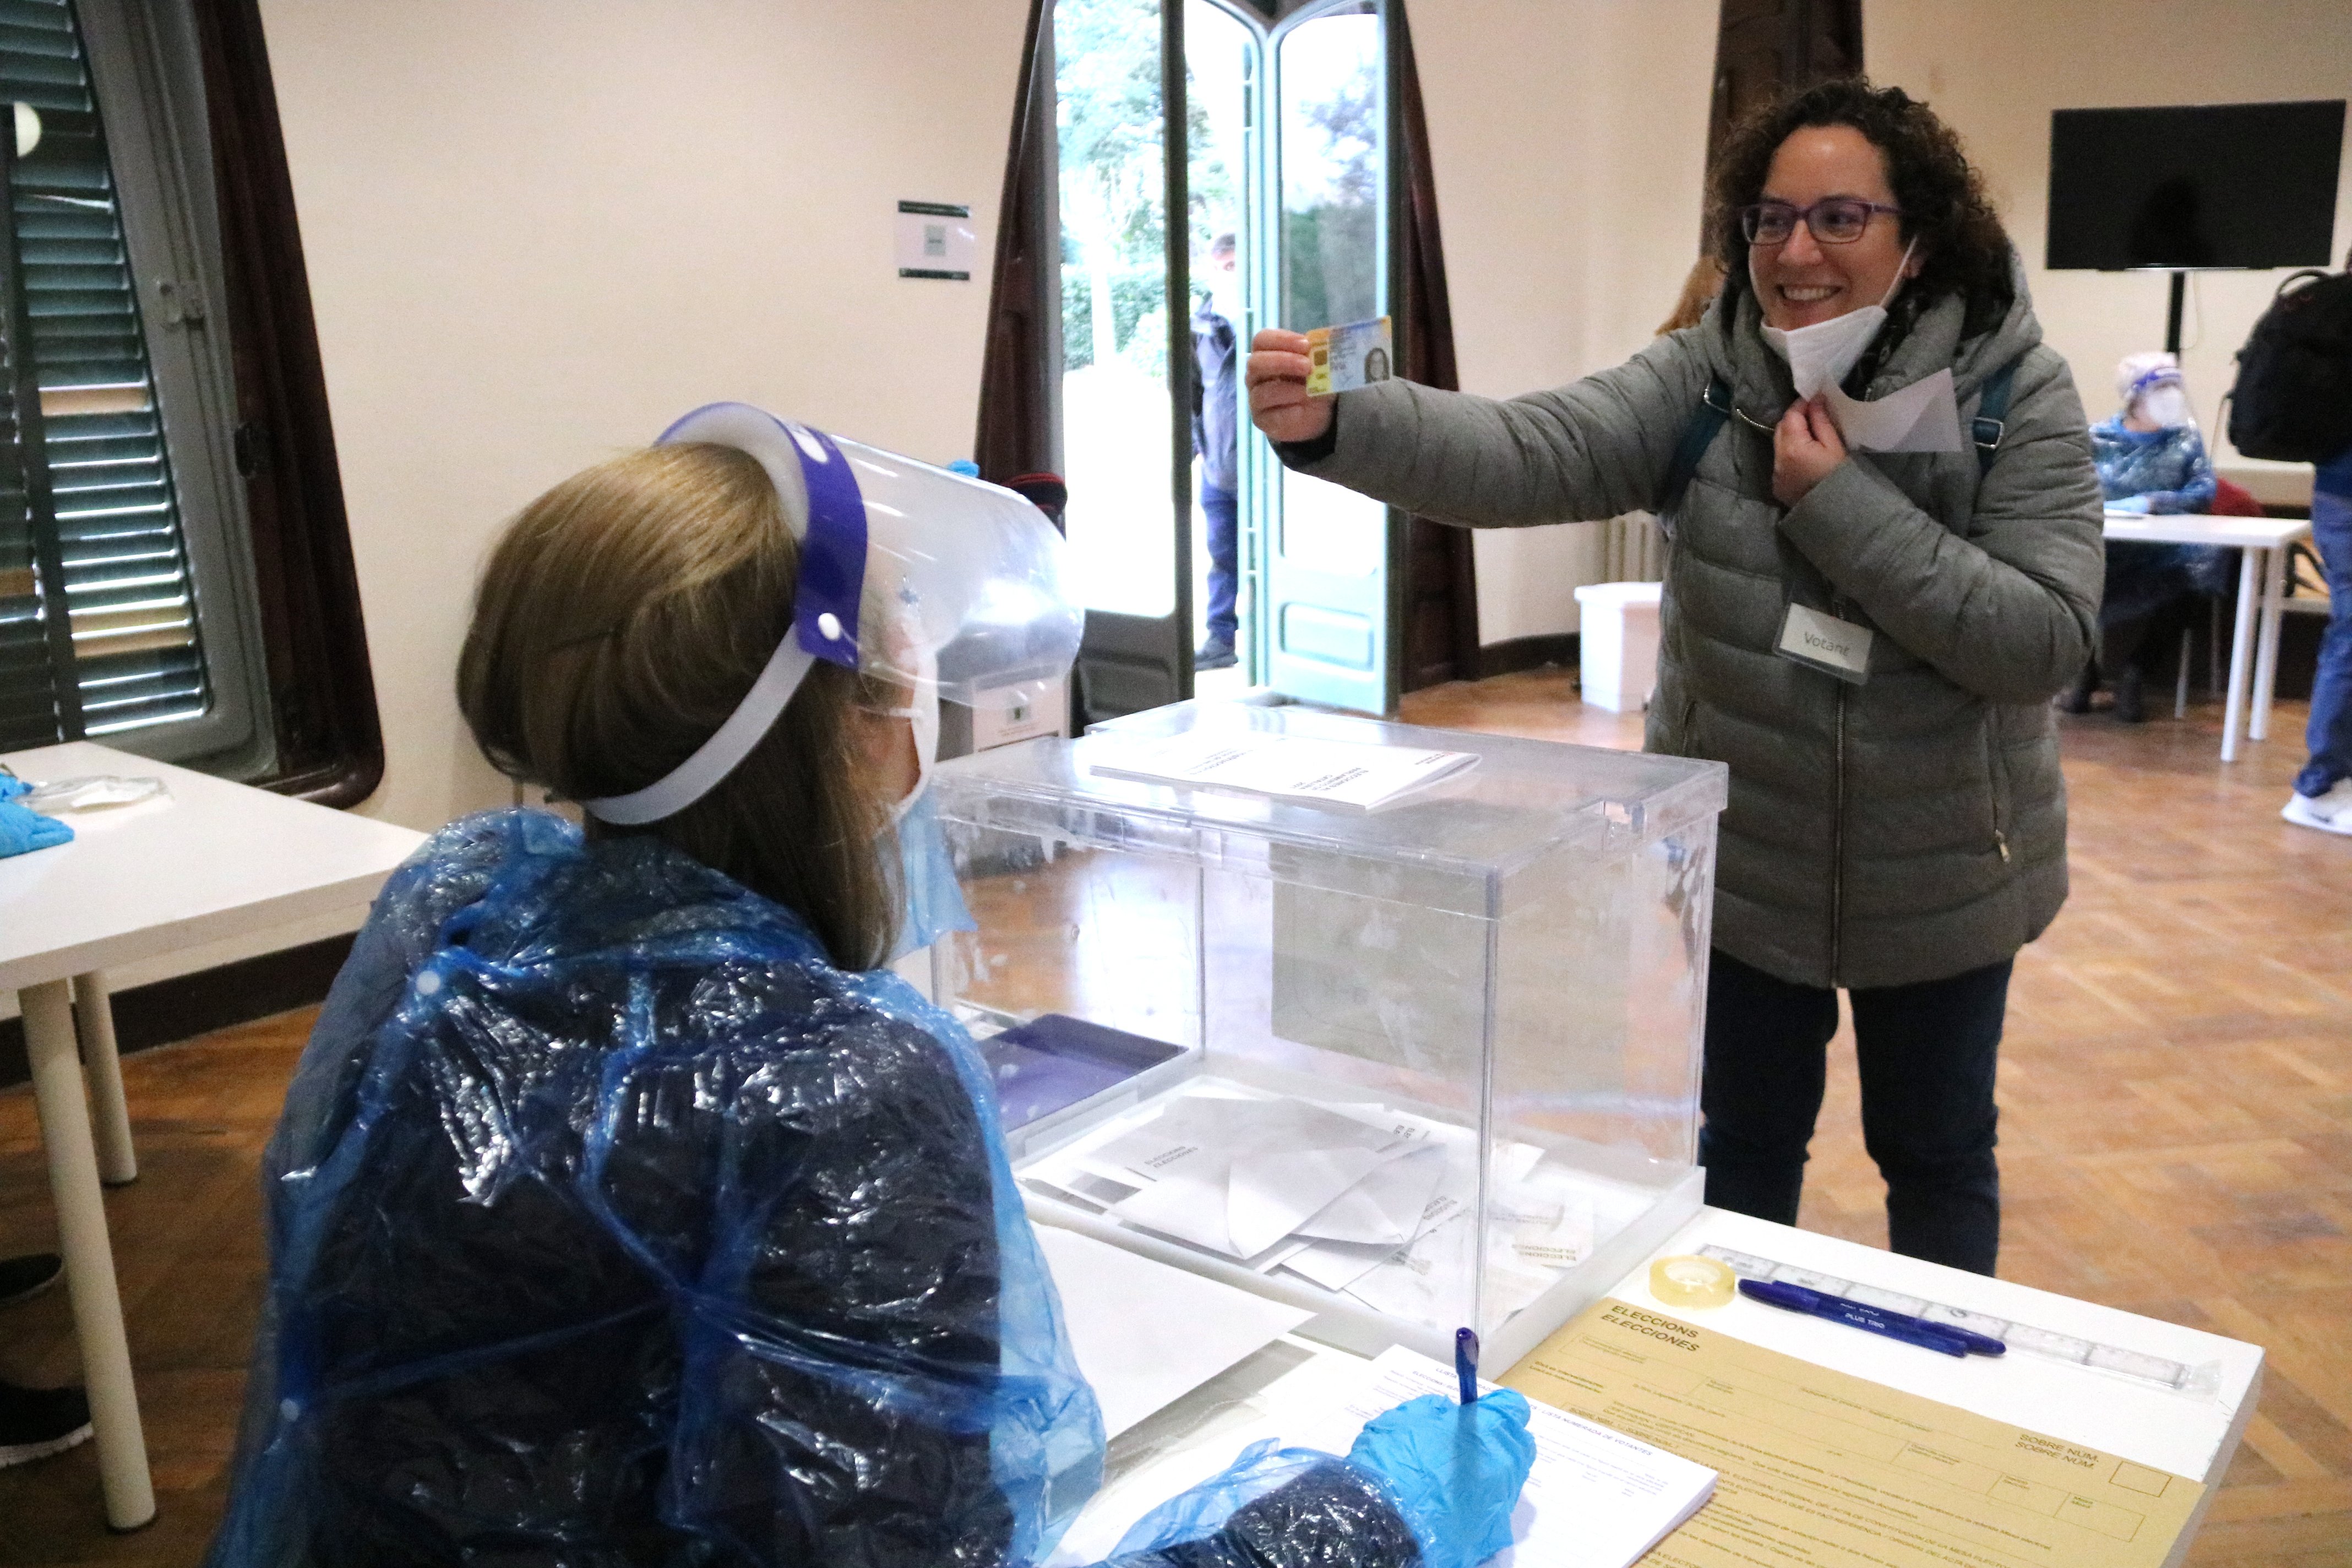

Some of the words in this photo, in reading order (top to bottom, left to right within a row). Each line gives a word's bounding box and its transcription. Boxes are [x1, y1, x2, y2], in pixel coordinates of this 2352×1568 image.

[1804, 631, 1850, 657] Votant
[1144, 1146, 1185, 1165] ELECCIONS
[1153, 1146, 1199, 1168] ELECCIONES
[1518, 1250, 1577, 1261] ELECCIONS
[1609, 1305, 1701, 1338] ELECCIONS
[1845, 1313, 1865, 1324] PLUS
[1599, 1313, 1702, 1351] ELECCIONES
[1434, 1367, 1458, 1379] LLISTA
[1561, 1417, 1603, 1436] NUMERADA
[1613, 1438, 1653, 1456] VOTANTES
[2016, 1441, 2061, 1458] SOBRE
[2020, 1434, 2065, 1450] SOBRE
[1948, 1546, 1973, 1558] MESA
